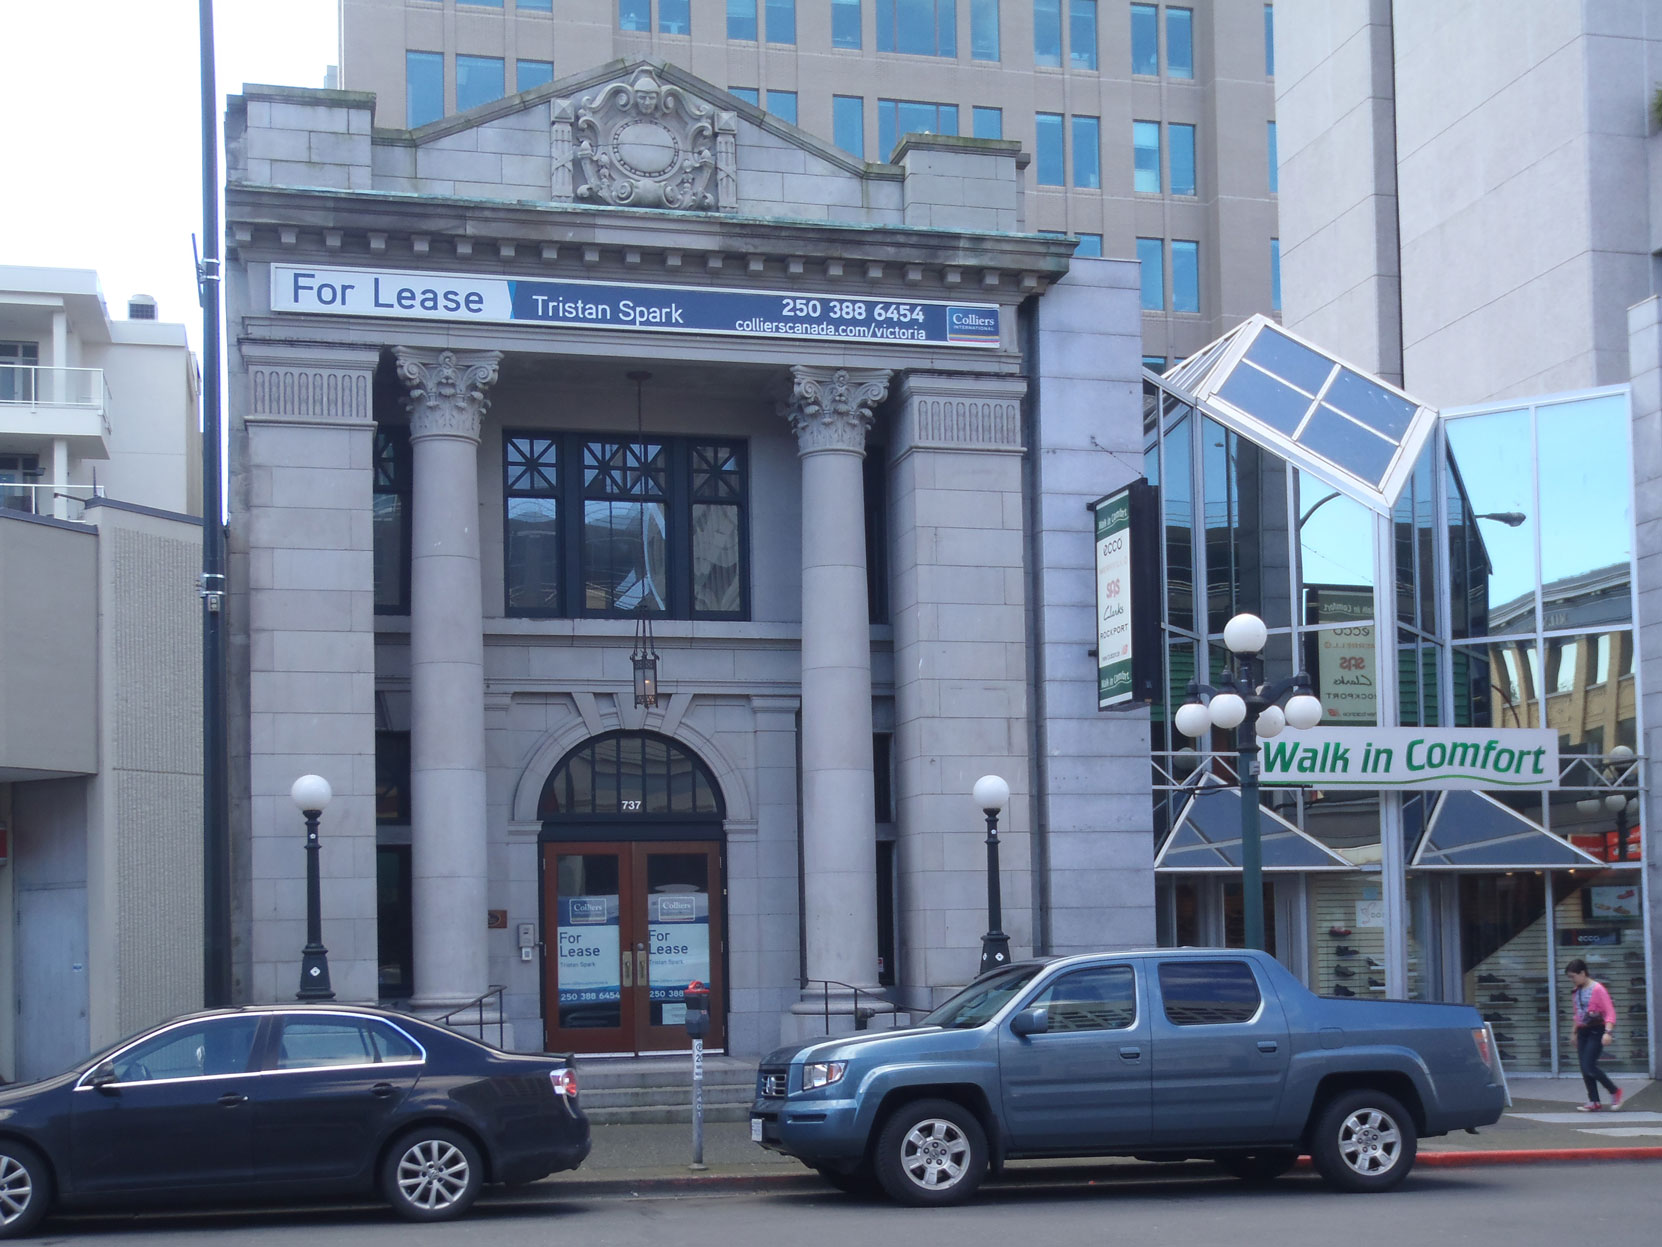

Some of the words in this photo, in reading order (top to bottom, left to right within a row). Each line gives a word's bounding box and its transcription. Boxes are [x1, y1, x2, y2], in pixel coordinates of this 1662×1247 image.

[293, 272, 355, 306] For
[374, 277, 484, 314] Lease
[532, 295, 611, 320] Tristan
[618, 300, 684, 327] Spark
[782, 298, 821, 317] 250
[829, 301, 867, 320] 388
[873, 303, 925, 323] 6454
[952, 313, 995, 326] Colliers
[735, 318, 927, 341] collierscanada.com/victoria
[1103, 537, 1123, 557] ecco
[1103, 603, 1124, 621] Clarks
[1100, 623, 1129, 639] ROCKPORT
[1262, 741, 1350, 773] Walk
[1361, 742, 1394, 773] in
[1406, 738, 1546, 774] Comfort
[621, 800, 642, 810] 737
[573, 903, 603, 912] Colliers
[662, 901, 691, 910] Colliers
[559, 932, 582, 944] For
[648, 930, 671, 942] For
[559, 945, 601, 958] Lease
[648, 942, 689, 955] Lease
[560, 993, 578, 1001] 250
[580, 992, 597, 1000] 388
[599, 991, 620, 1000] 6454
[649, 990, 666, 998] 250
